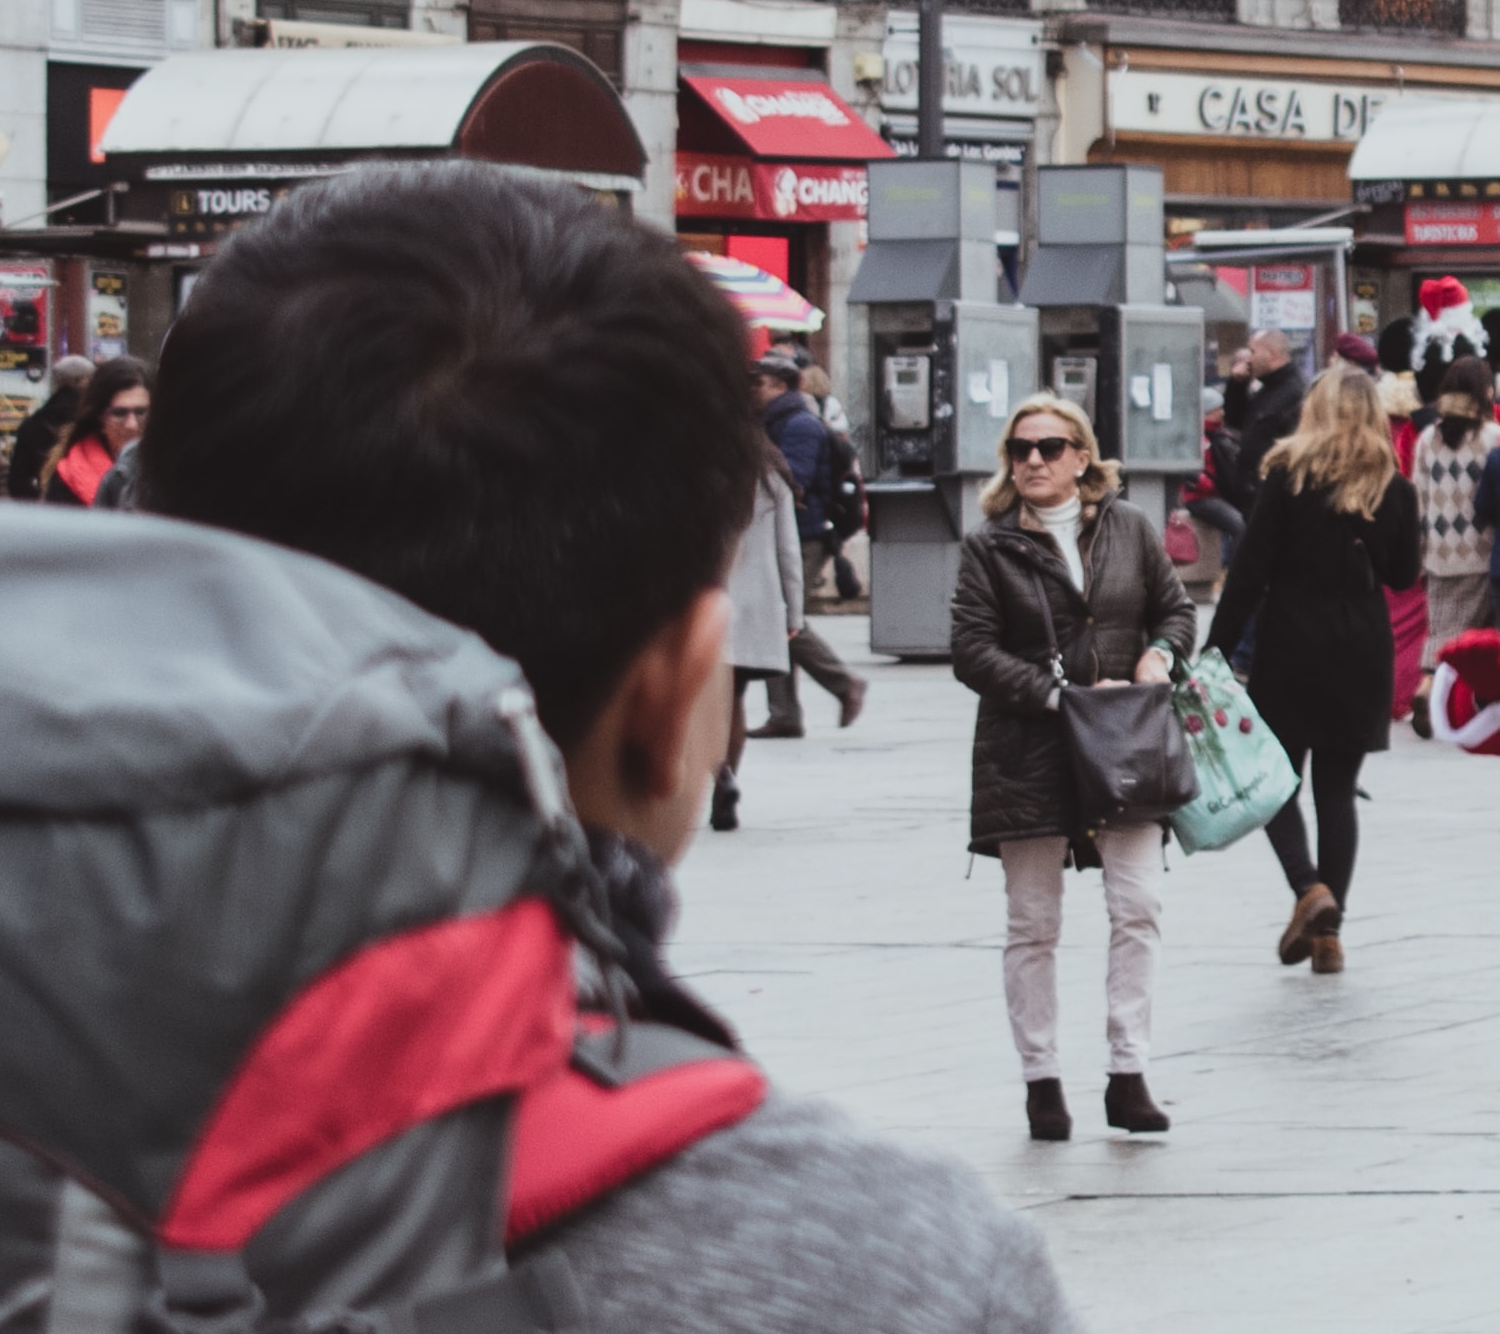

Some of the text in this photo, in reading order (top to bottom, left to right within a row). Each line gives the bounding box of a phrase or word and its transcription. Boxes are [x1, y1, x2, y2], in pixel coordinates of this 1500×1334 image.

[884, 59, 1039, 102] LORIA SOL
[1198, 85, 1307, 135] CASA
[198, 189, 270, 213] TOURS
[692, 165, 755, 203] CHA
[800, 176, 868, 205] CHANG
